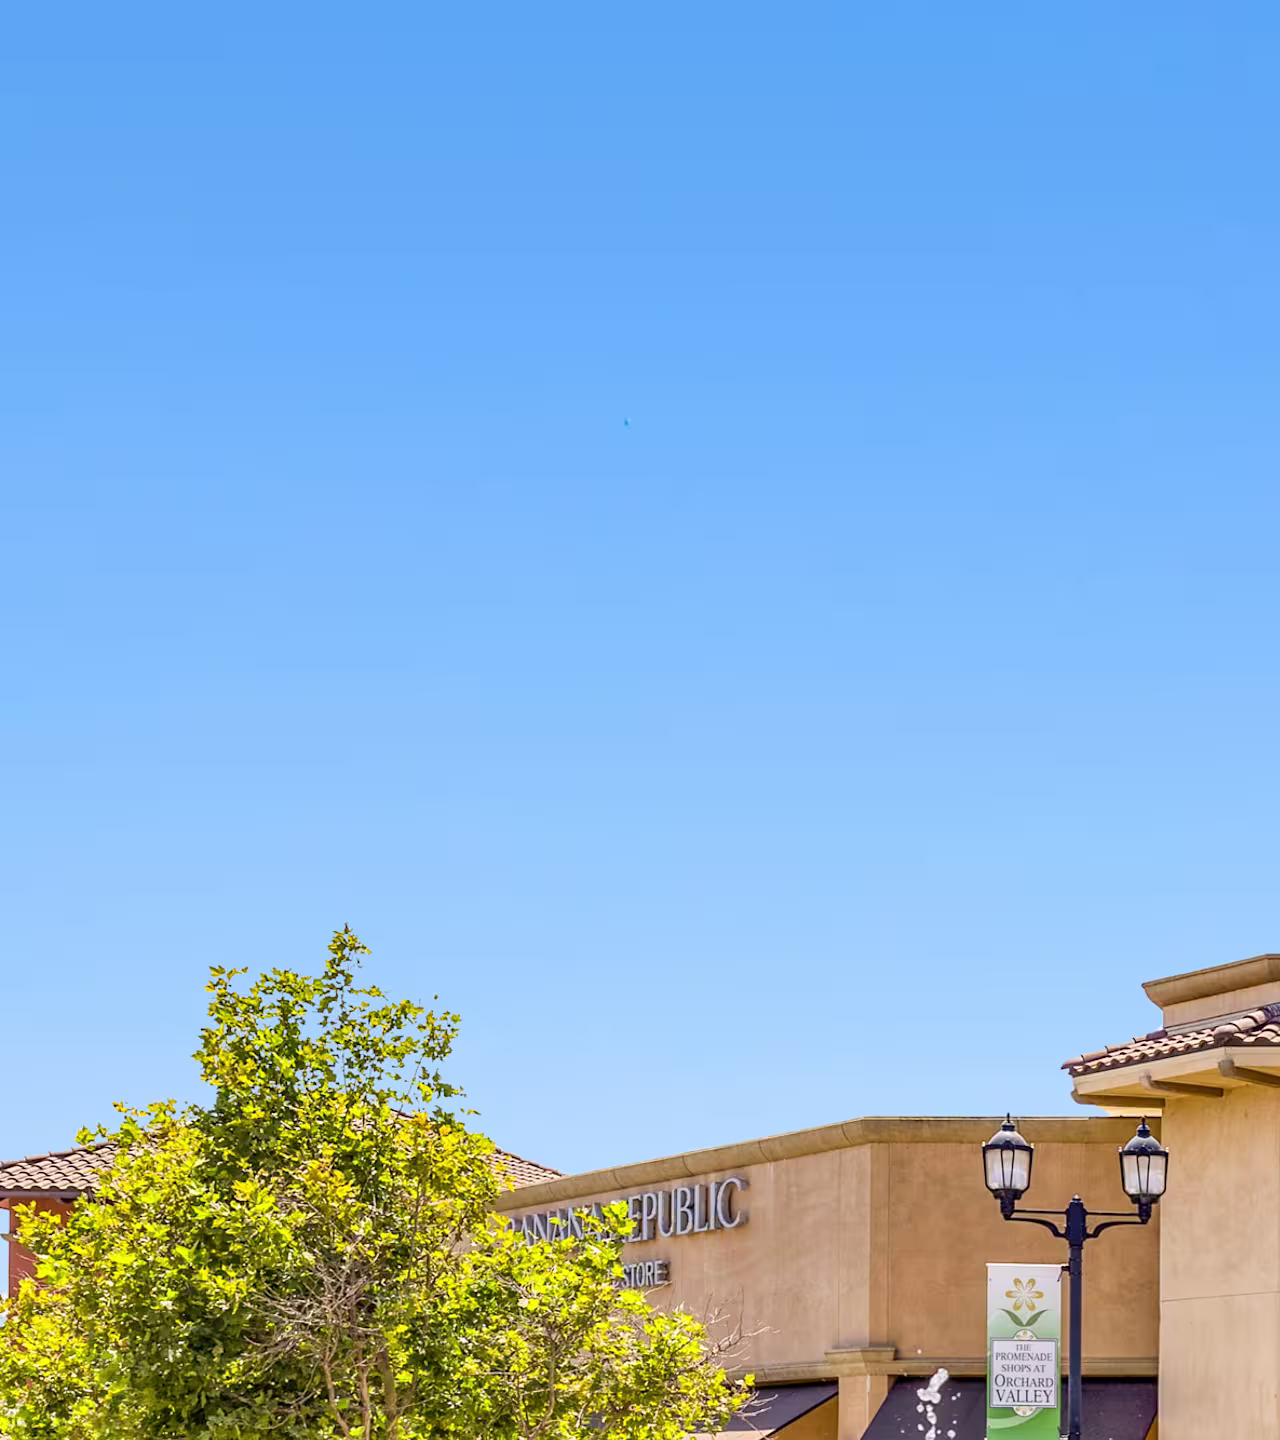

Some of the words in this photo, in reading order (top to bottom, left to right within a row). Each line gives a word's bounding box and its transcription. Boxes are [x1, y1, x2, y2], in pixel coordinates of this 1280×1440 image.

[612, 1178, 745, 1243] EPUBLIC
[621, 1260, 664, 1288] STORE
[995, 1352, 1052, 1361] PROMENADE
[1001, 1364, 1031, 1373] SHOPS
[1033, 1364, 1046, 1373] AT
[994, 1374, 1054, 1388] ORCHARD
[996, 1389, 1053, 1404] VALLEY
